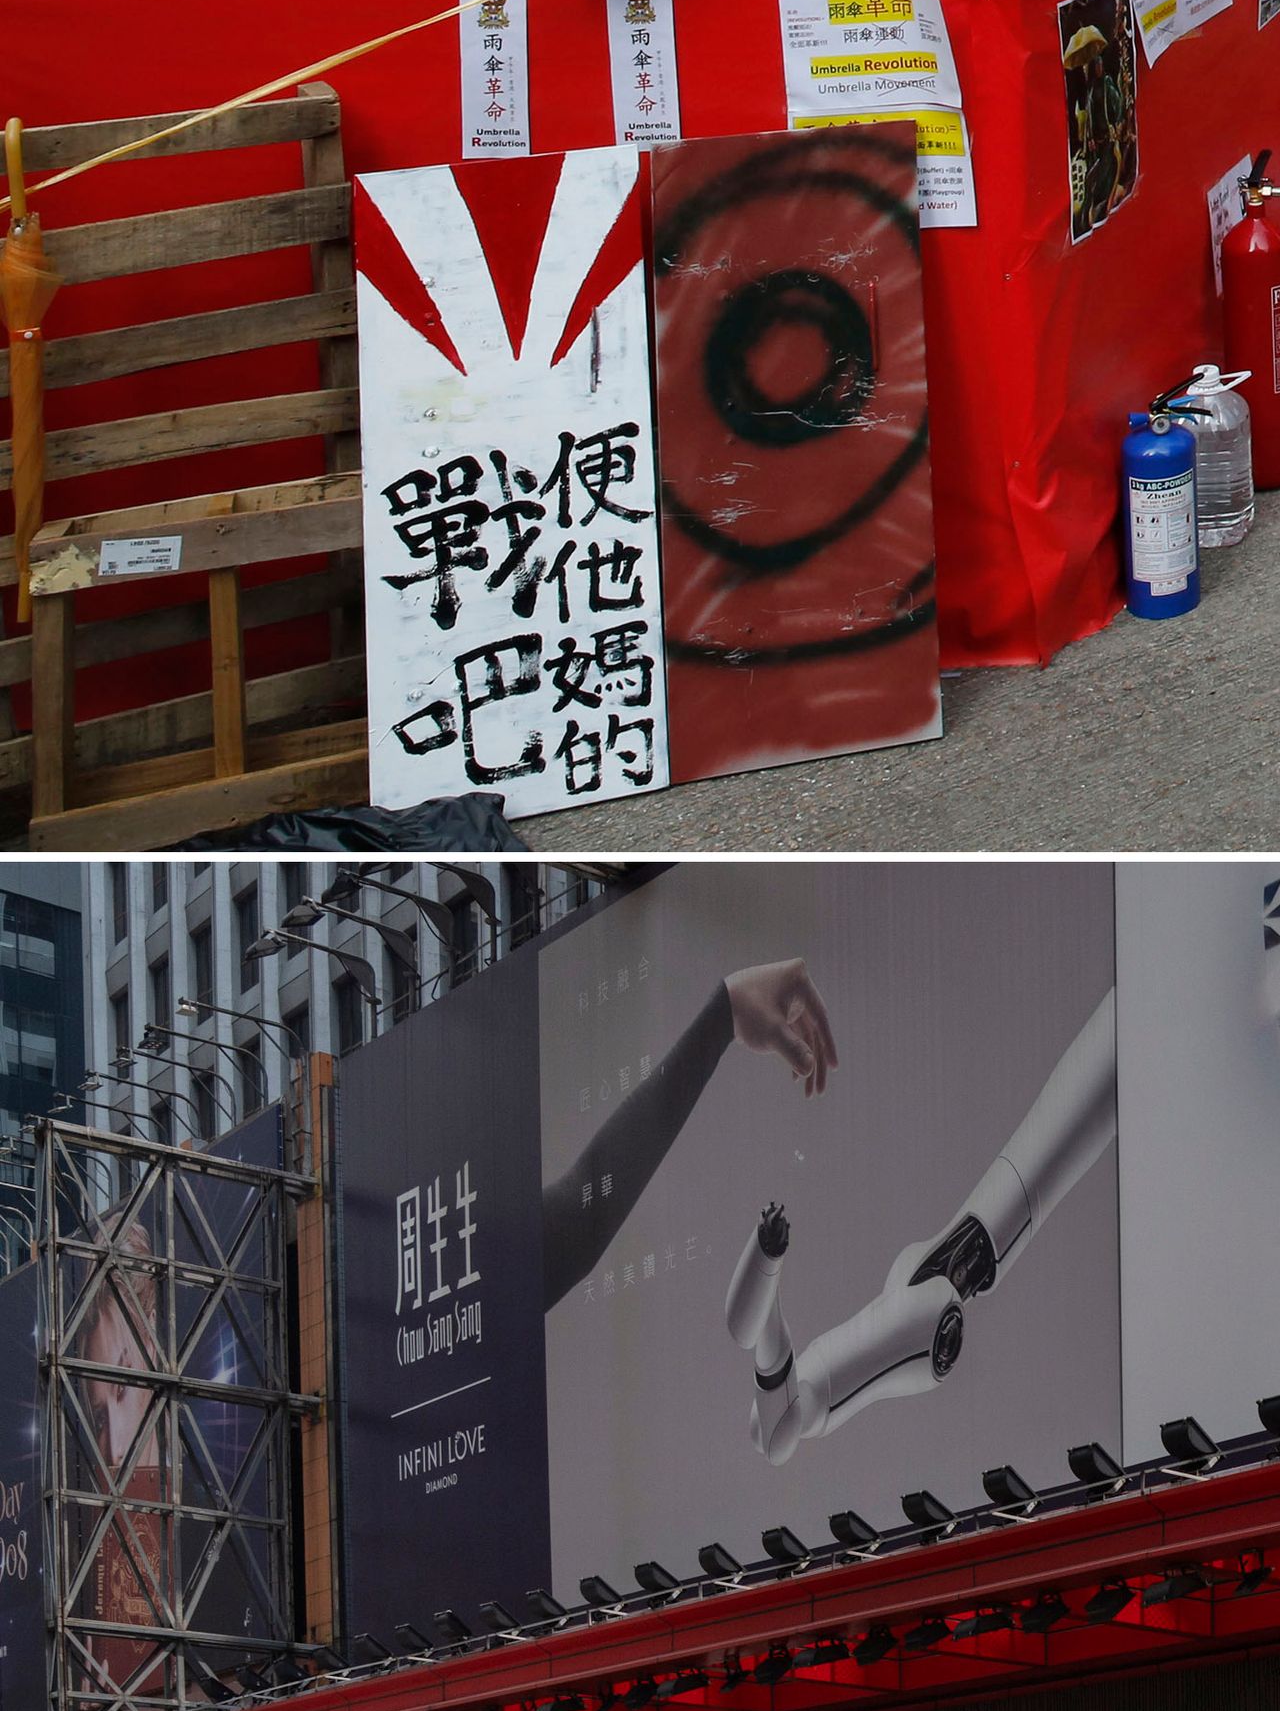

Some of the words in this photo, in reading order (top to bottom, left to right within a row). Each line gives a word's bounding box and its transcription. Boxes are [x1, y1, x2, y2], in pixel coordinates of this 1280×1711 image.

[631, 28, 657, 117] 雨傘革命
[810, 63, 861, 75] Umbrella
[864, 56, 938, 72] Revolution
[483, 33, 507, 123] 雨傘革命
[818, 82, 871, 95] Umbrella
[476, 128, 521, 136] Umbrella
[624, 130, 678, 142] Revolution
[628, 121, 672, 130] Umbrella
[471, 137, 526, 148] Revolution
[1147, 489, 1182, 500] Zhean
[380, 449, 547, 784] 戰吧
[547, 422, 653, 794] 便他媽的
[395, 1160, 481, 1316] 周生生
[396, 1323, 425, 1366] Chow
[426, 1313, 453, 1356] Sang
[455, 1300, 482, 1345] Sang
[398, 1433, 443, 1481] INFINI
[448, 1424, 486, 1461] LOVE
[425, 1473, 458, 1495] DIAMOND
